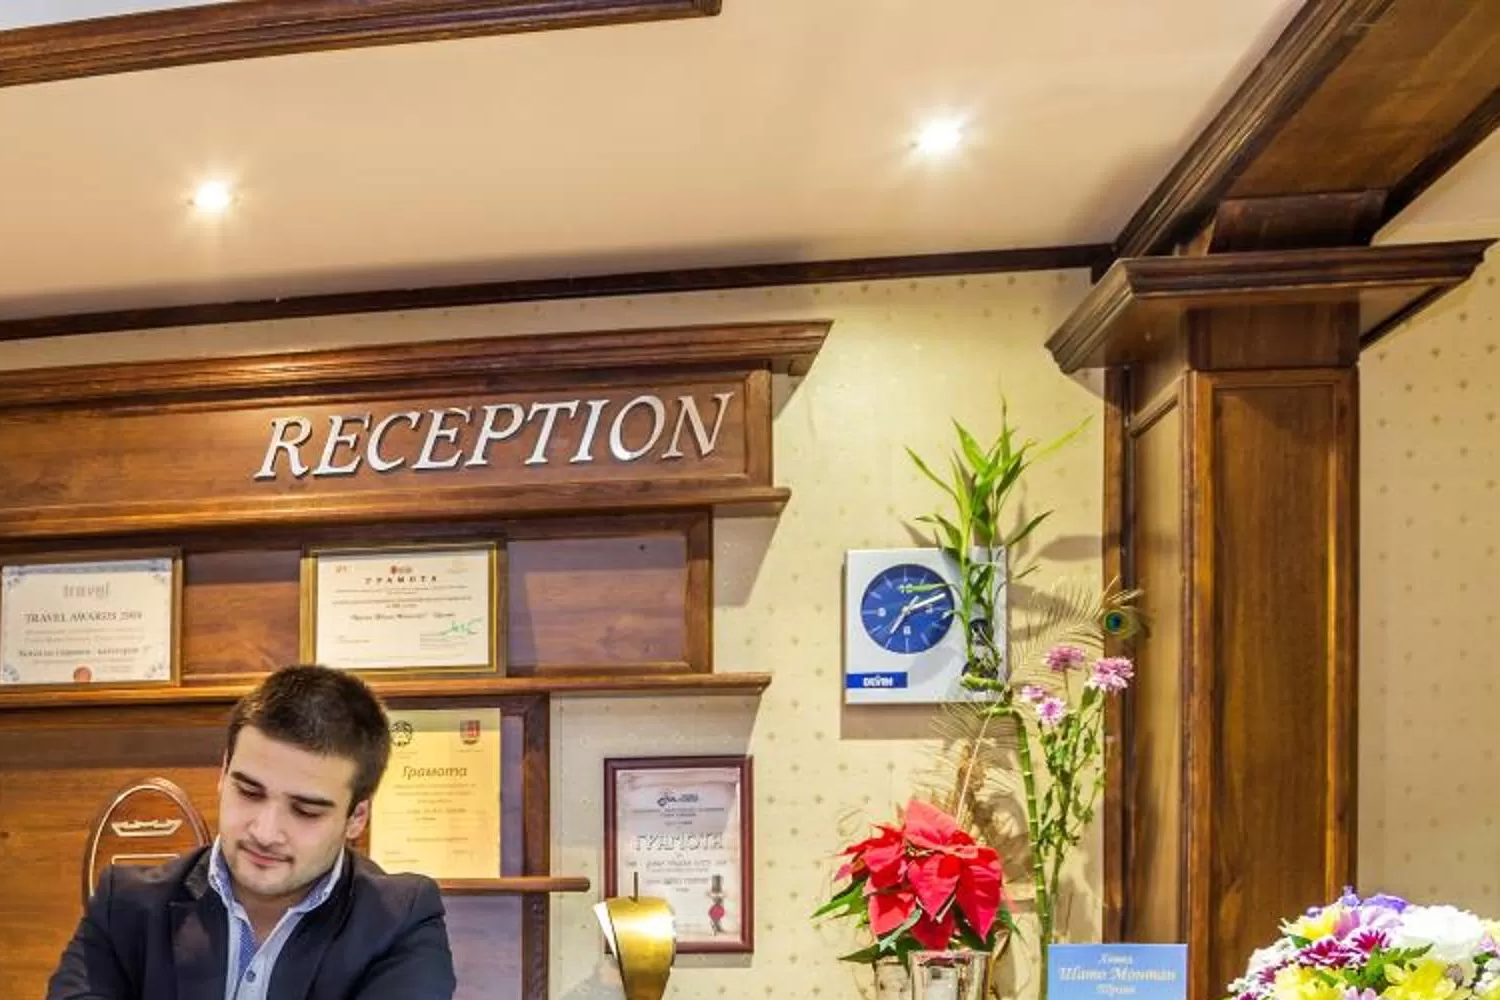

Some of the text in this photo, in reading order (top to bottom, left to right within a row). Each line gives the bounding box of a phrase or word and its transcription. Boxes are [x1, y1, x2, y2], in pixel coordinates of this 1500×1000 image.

[253, 393, 735, 481] RECEPTION
[63, 581, 111, 599] travel
[25, 612, 68, 624] TRAVEL
[69, 611, 117, 623] AWARDS
[402, 766, 469, 780] Грамота
